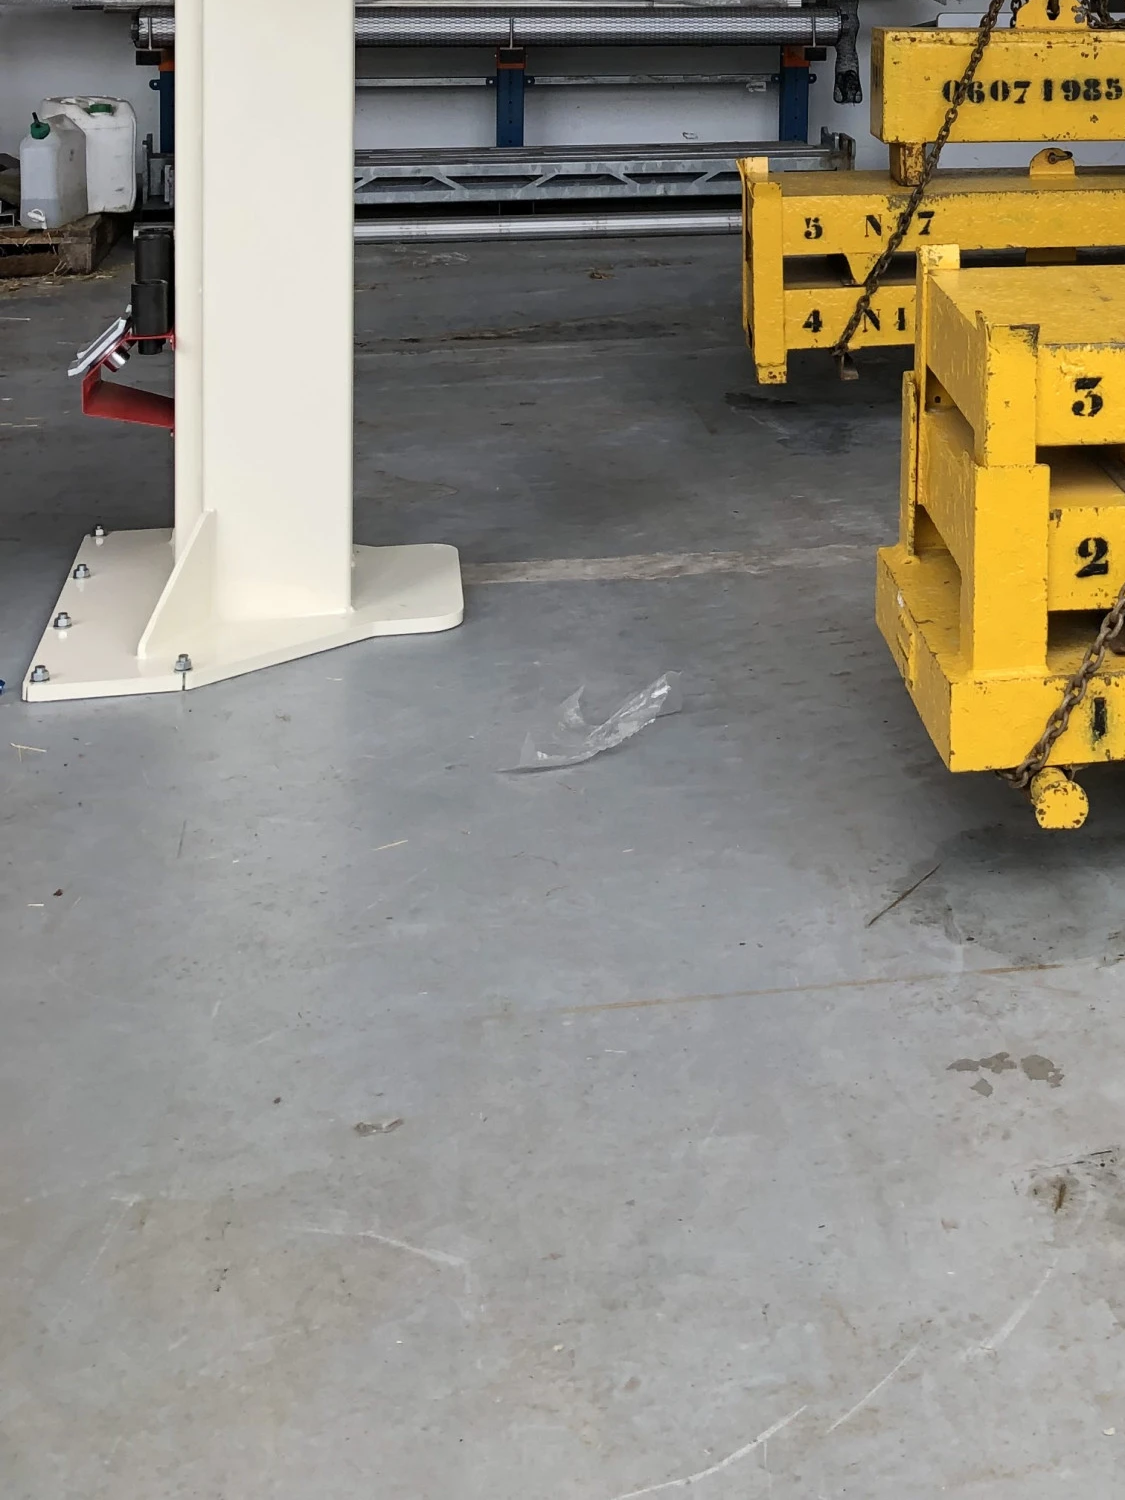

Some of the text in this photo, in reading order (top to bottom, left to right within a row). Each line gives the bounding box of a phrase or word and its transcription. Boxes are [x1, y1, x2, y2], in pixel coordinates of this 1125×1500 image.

[803, 217, 823, 240] 5
[802, 309, 823, 333] 4
[1071, 376, 1104, 417] 3
[1075, 536, 1110, 578] 2
